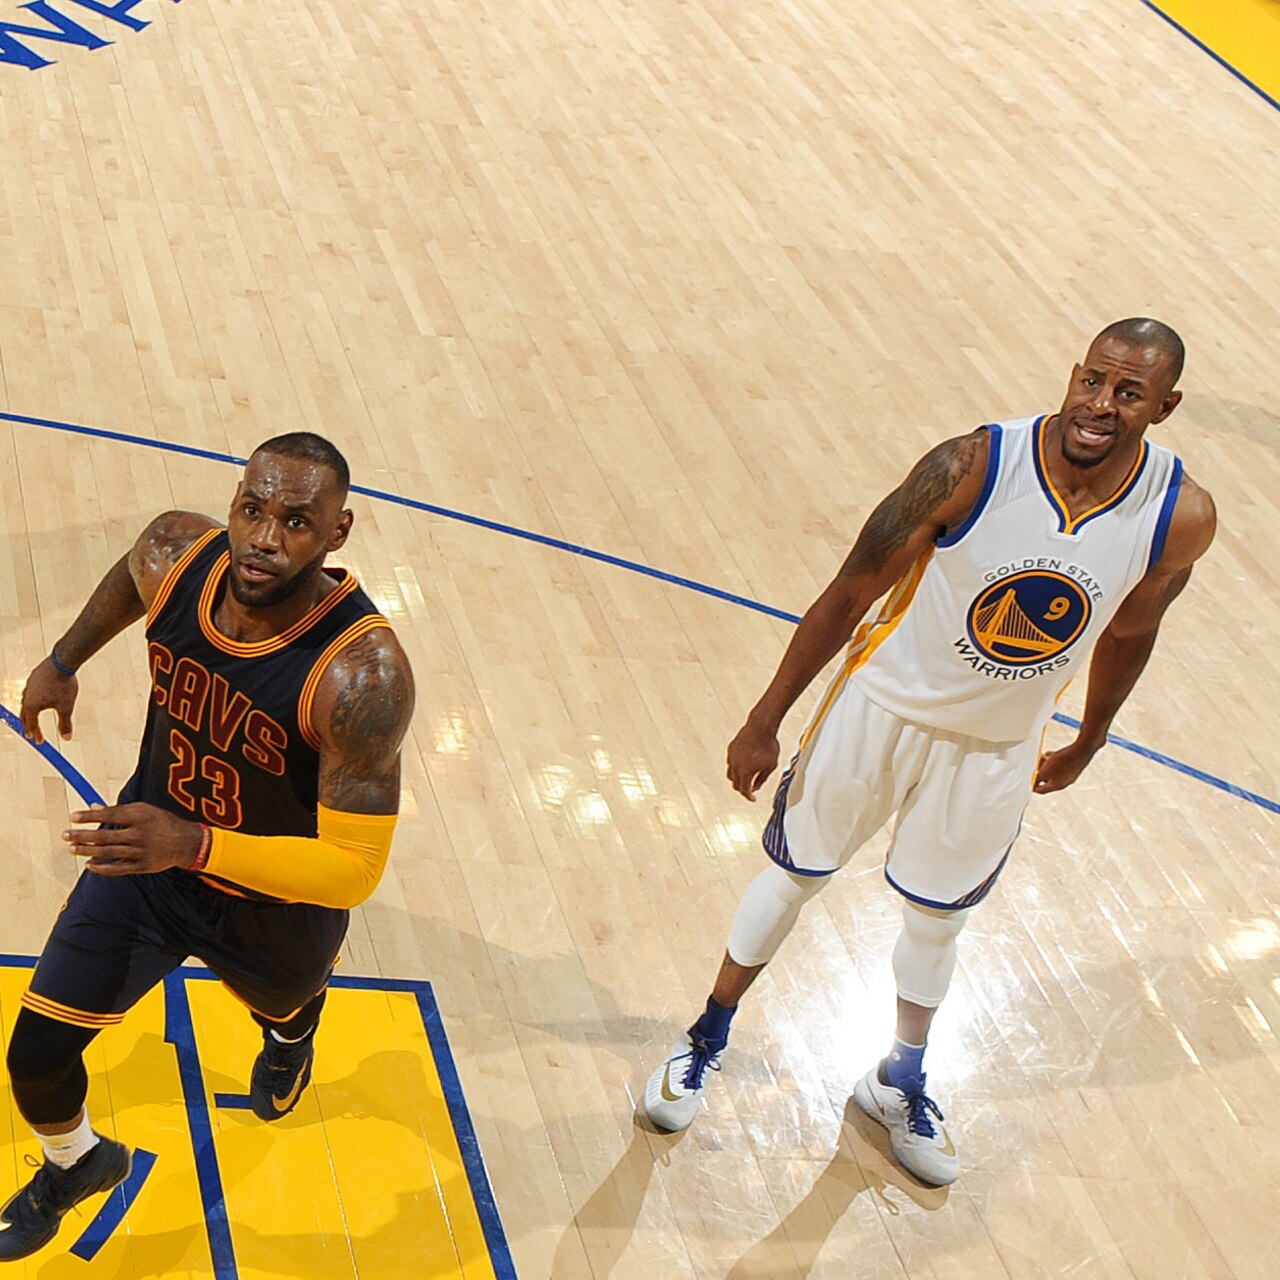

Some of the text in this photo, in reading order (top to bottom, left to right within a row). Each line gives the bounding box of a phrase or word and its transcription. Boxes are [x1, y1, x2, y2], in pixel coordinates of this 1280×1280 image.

[983, 557, 1105, 603] GOLDEN STATE
[1042, 595, 1072, 623] 9
[953, 636, 1072, 682] WARRIORS
[148, 641, 288, 777] CAVS
[167, 729, 243, 829] 23
